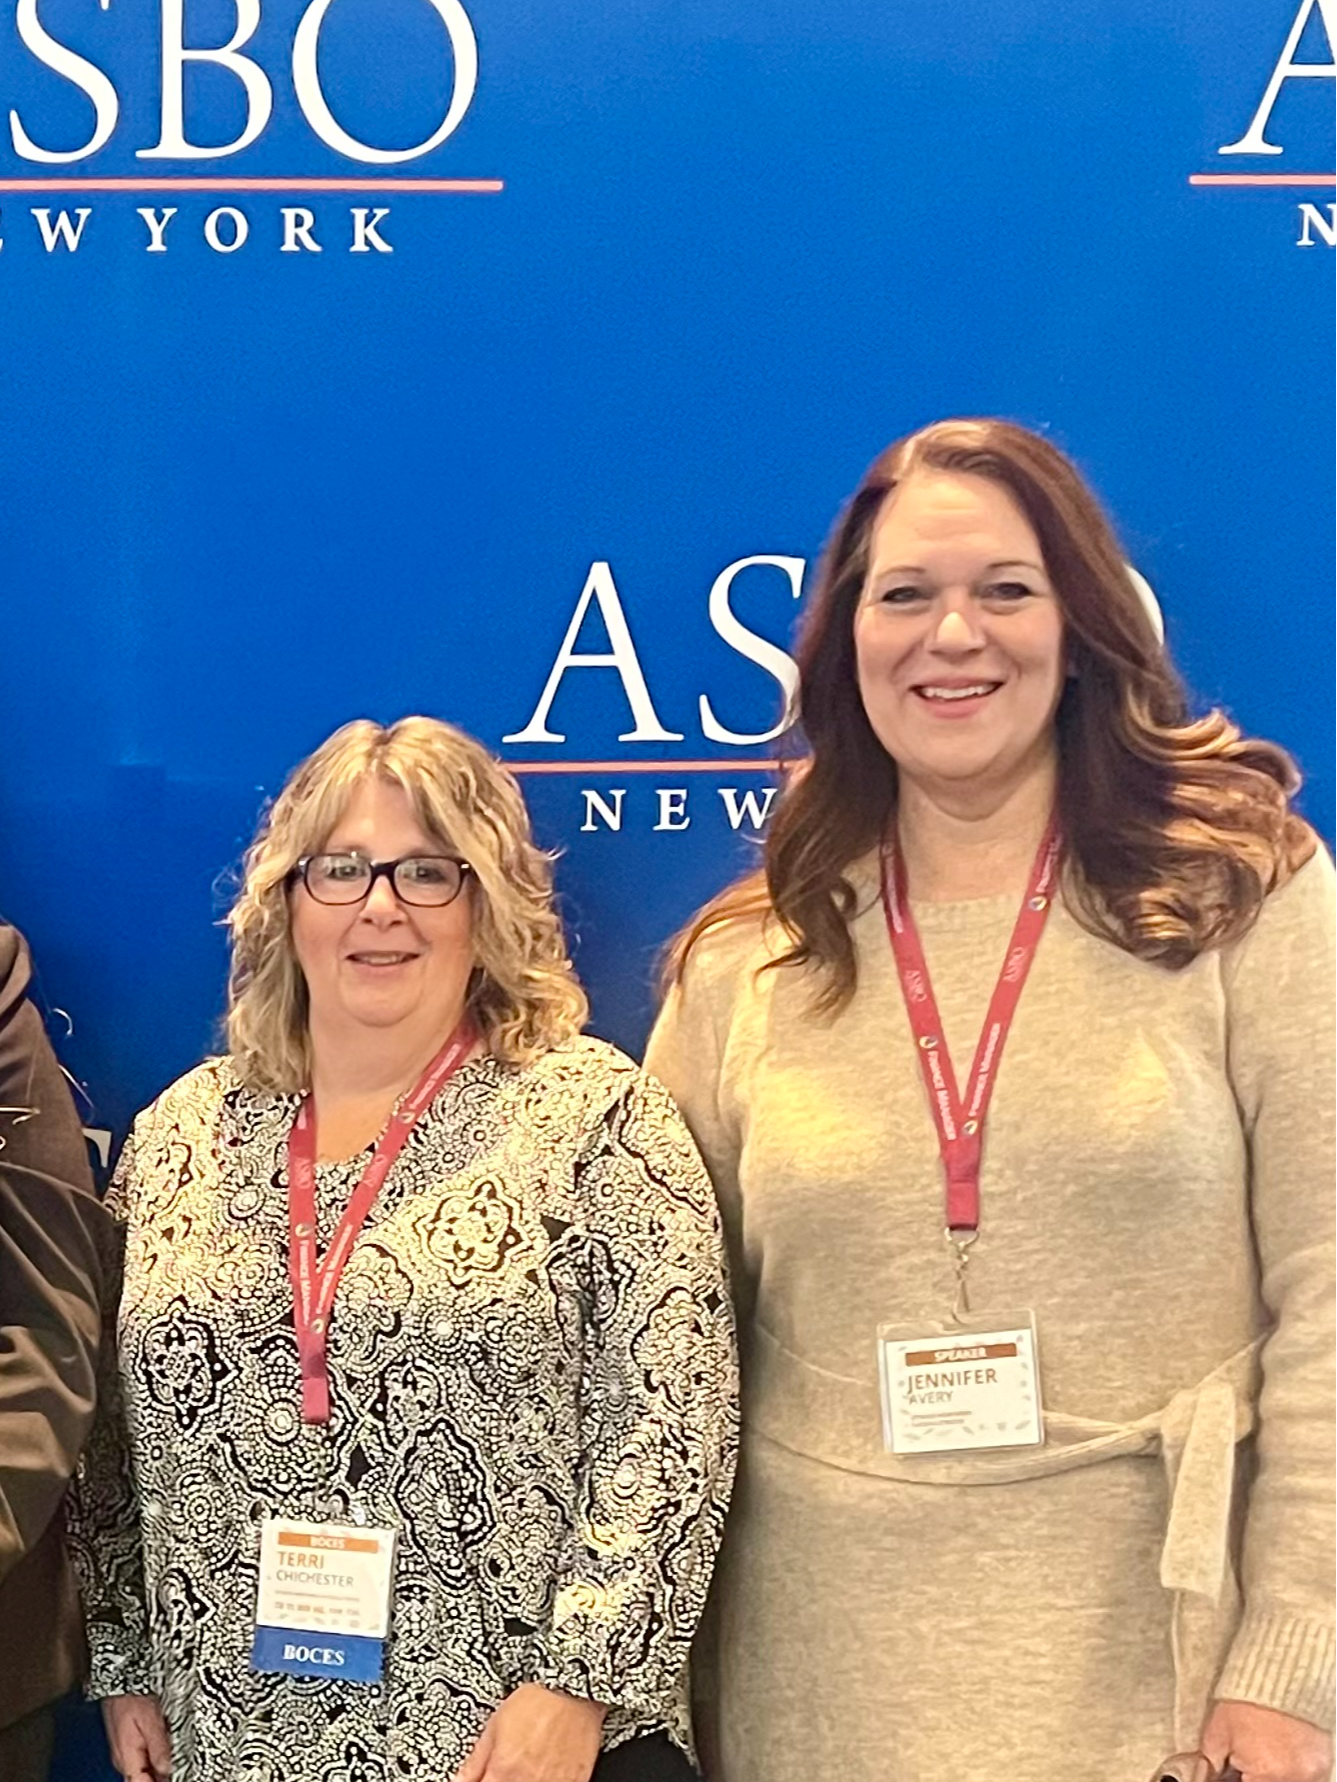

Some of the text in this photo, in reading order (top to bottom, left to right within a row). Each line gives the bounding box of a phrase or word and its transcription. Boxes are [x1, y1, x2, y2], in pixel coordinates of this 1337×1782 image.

[136, 208, 393, 253] YORK
[580, 788, 778, 831] NEW
[934, 1347, 987, 1362] SPEAKER
[907, 1368, 998, 1394] JENNIFER
[909, 1391, 954, 1405] AVERY
[310, 1536, 346, 1549] BOCES
[277, 1551, 324, 1569] TERRI
[276, 1569, 354, 1587] CHICHESTER
[283, 1644, 345, 1665] BOCES
